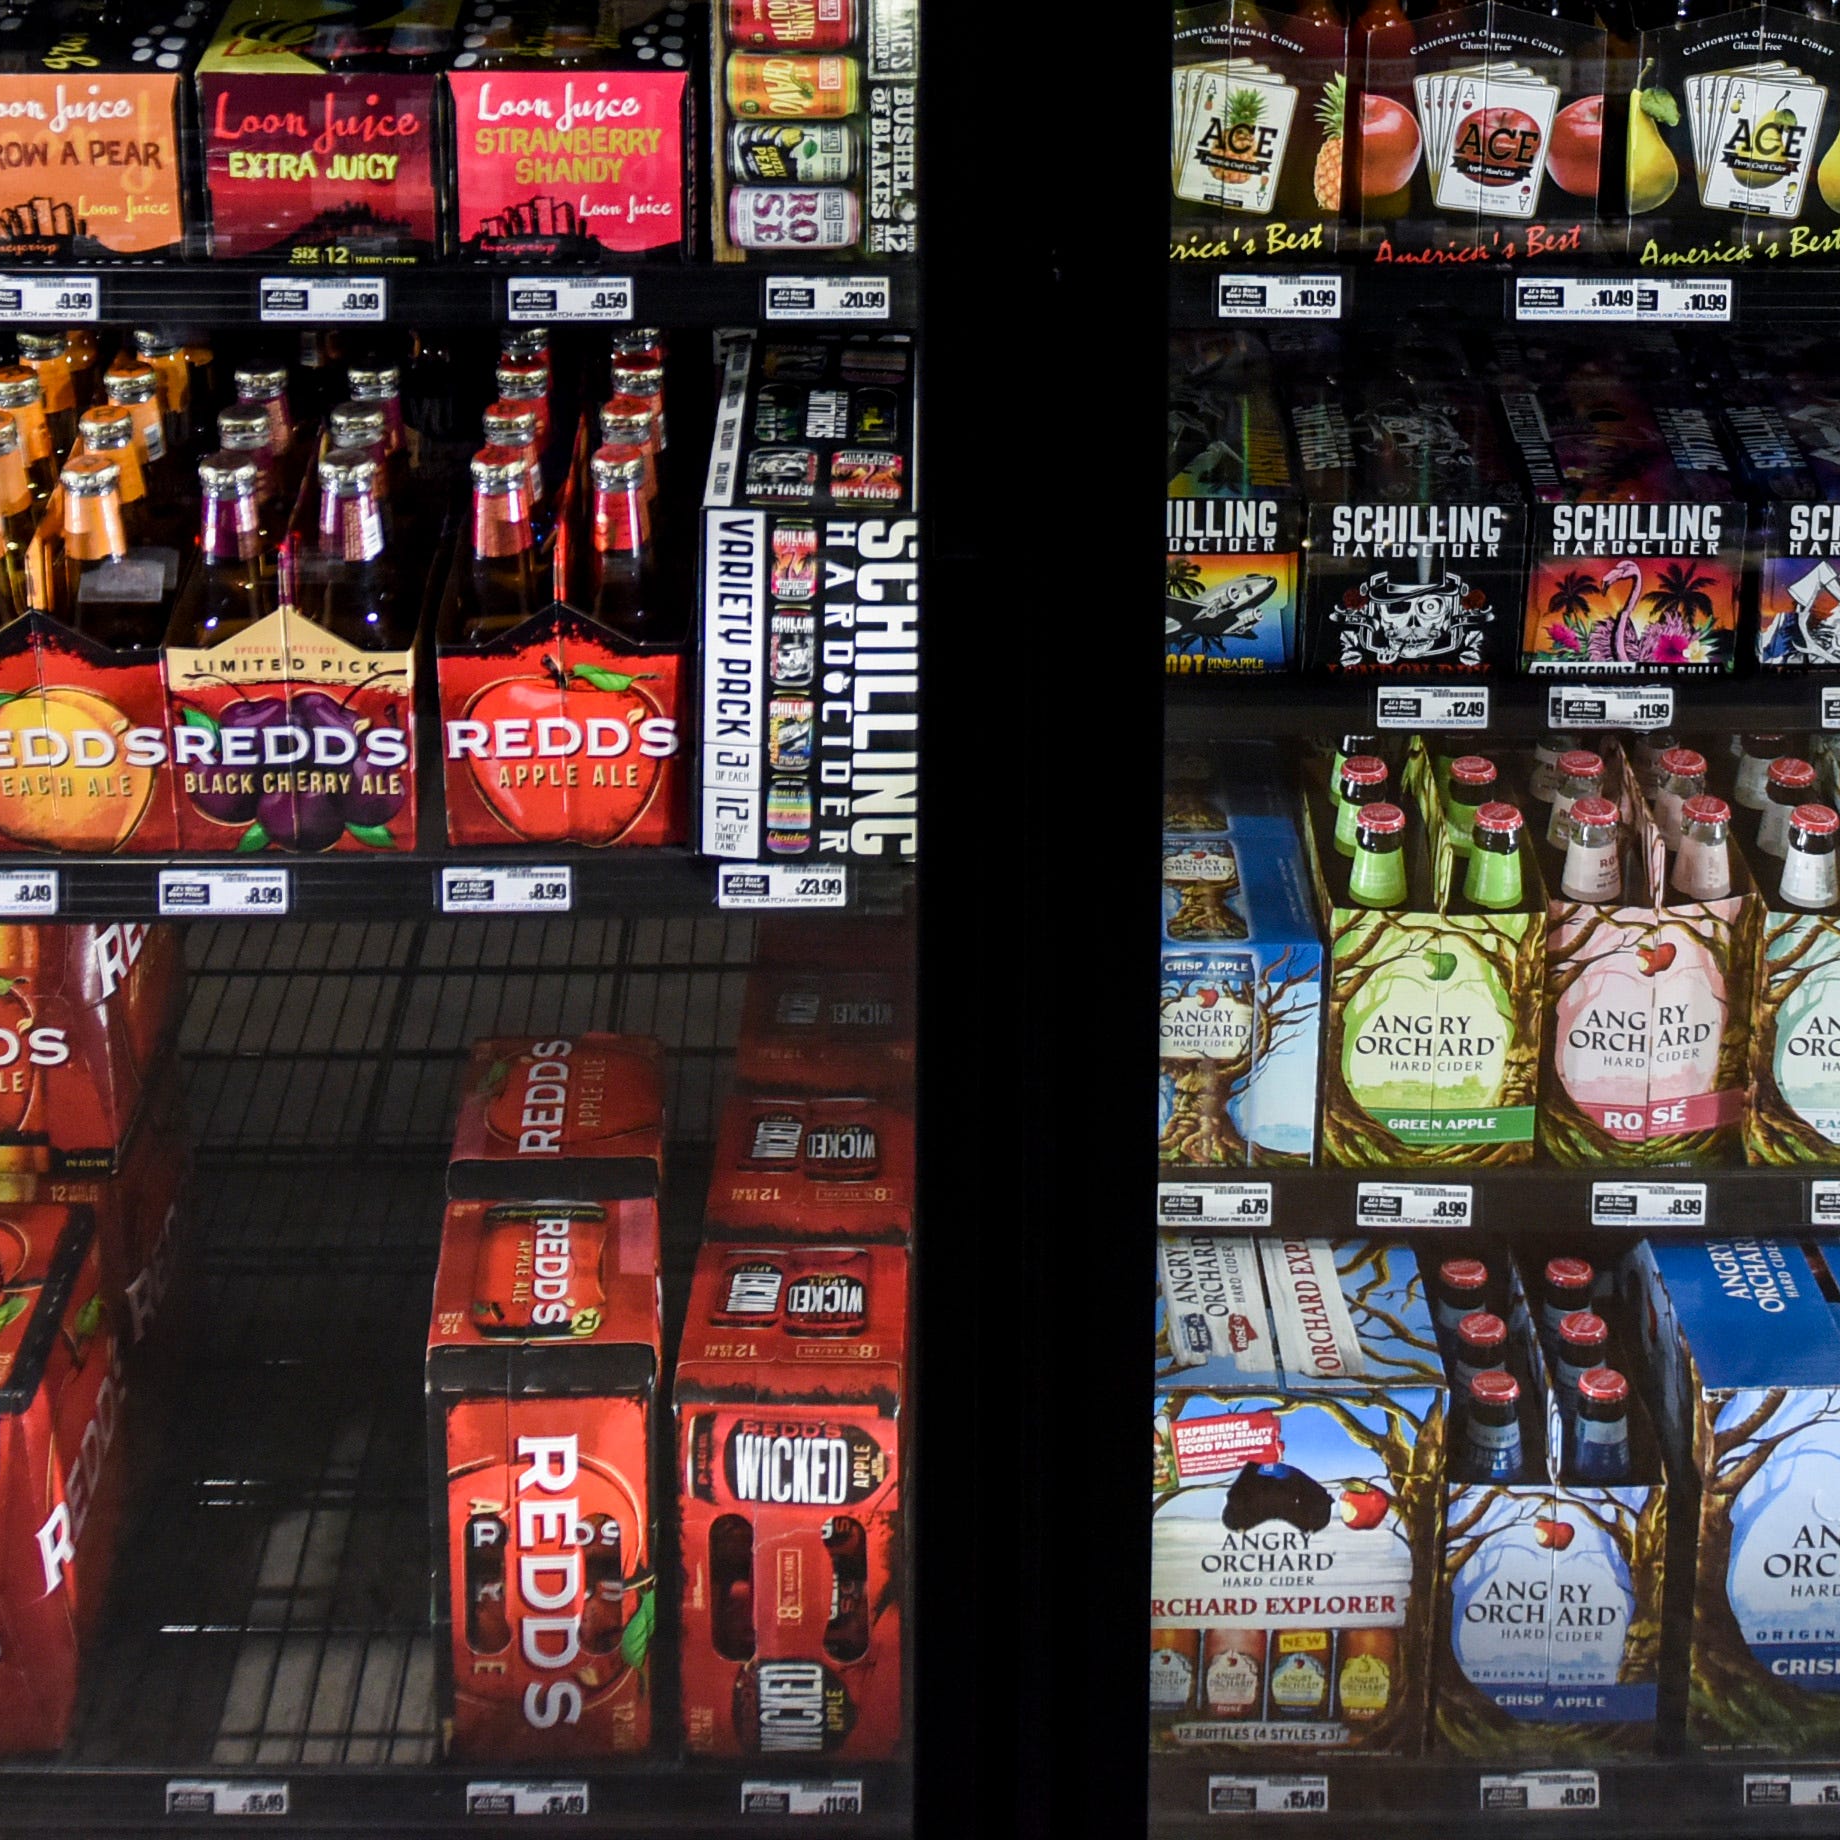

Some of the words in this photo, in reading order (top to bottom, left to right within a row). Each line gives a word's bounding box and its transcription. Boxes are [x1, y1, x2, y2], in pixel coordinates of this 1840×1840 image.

[61, 140, 78, 162] A
[89, 140, 162, 169] PEAR
[474, 126, 662, 156] STRAWBERRY
[514, 158, 624, 185] SHANDY
[1374, 230, 1519, 264] America's
[1525, 224, 1582, 250] Best
[841, 291, 886, 312] $20.99
[1332, 506, 1502, 543] SCHILLING
[717, 518, 754, 645] VARIETY
[716, 659, 752, 739] PACK
[850, 518, 919, 858] SCHILLING
[1446, 701, 1485, 719] $12.49
[445, 708, 680, 759] REDD'S
[86, 775, 132, 797] ALE
[184, 773, 255, 796] BLACK
[261, 772, 351, 796] CHERRY
[361, 774, 402, 796] ALE
[498, 764, 579, 790] APPLE
[592, 764, 640, 788] ALE
[1387, 1117, 1444, 1131] GREEN
[1448, 1117, 1497, 1130] APPLE
[1236, 1198, 1269, 1216] $6.79
[734, 1435, 850, 1507] WICKED
[1265, 1595, 1396, 1615] EXPLORER
[1195, 1728, 1251, 1740] BOTTLES
